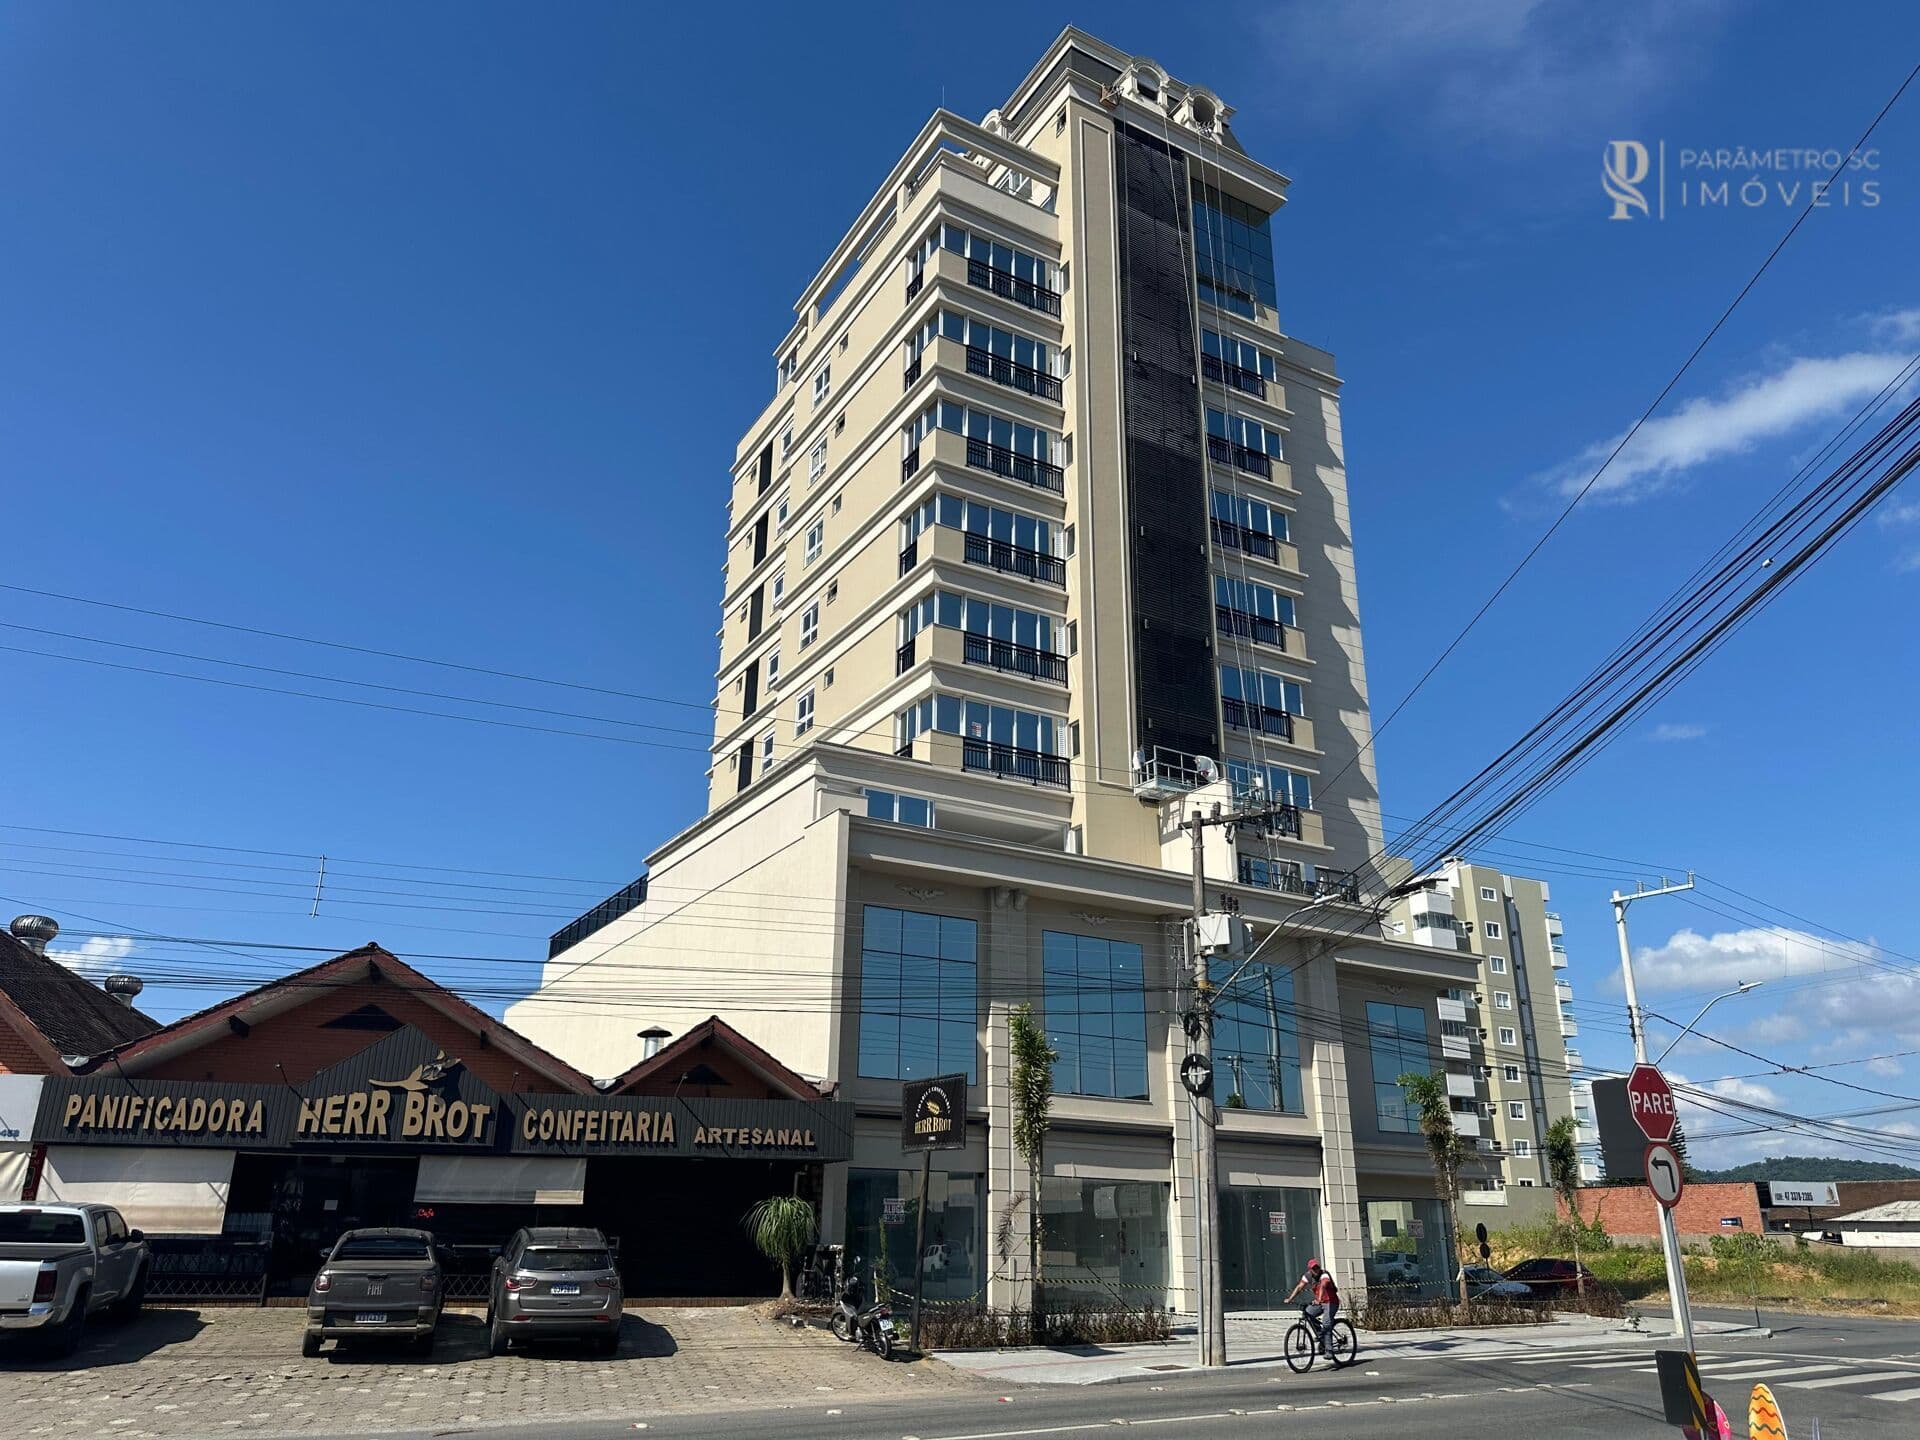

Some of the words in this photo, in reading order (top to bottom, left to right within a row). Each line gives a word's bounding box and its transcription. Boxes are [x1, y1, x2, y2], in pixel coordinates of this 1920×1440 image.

[63, 1094, 263, 1133] PANIFICADORA
[297, 1090, 391, 1135] HERR
[402, 1091, 491, 1138] BROT
[1631, 1091, 1673, 1115] PARE
[523, 1108, 675, 1143] CONFEITARIA
[694, 1126, 815, 1146] ARTESANAL
[914, 1117, 932, 1134] HERR
[933, 1117, 952, 1132] BROT
